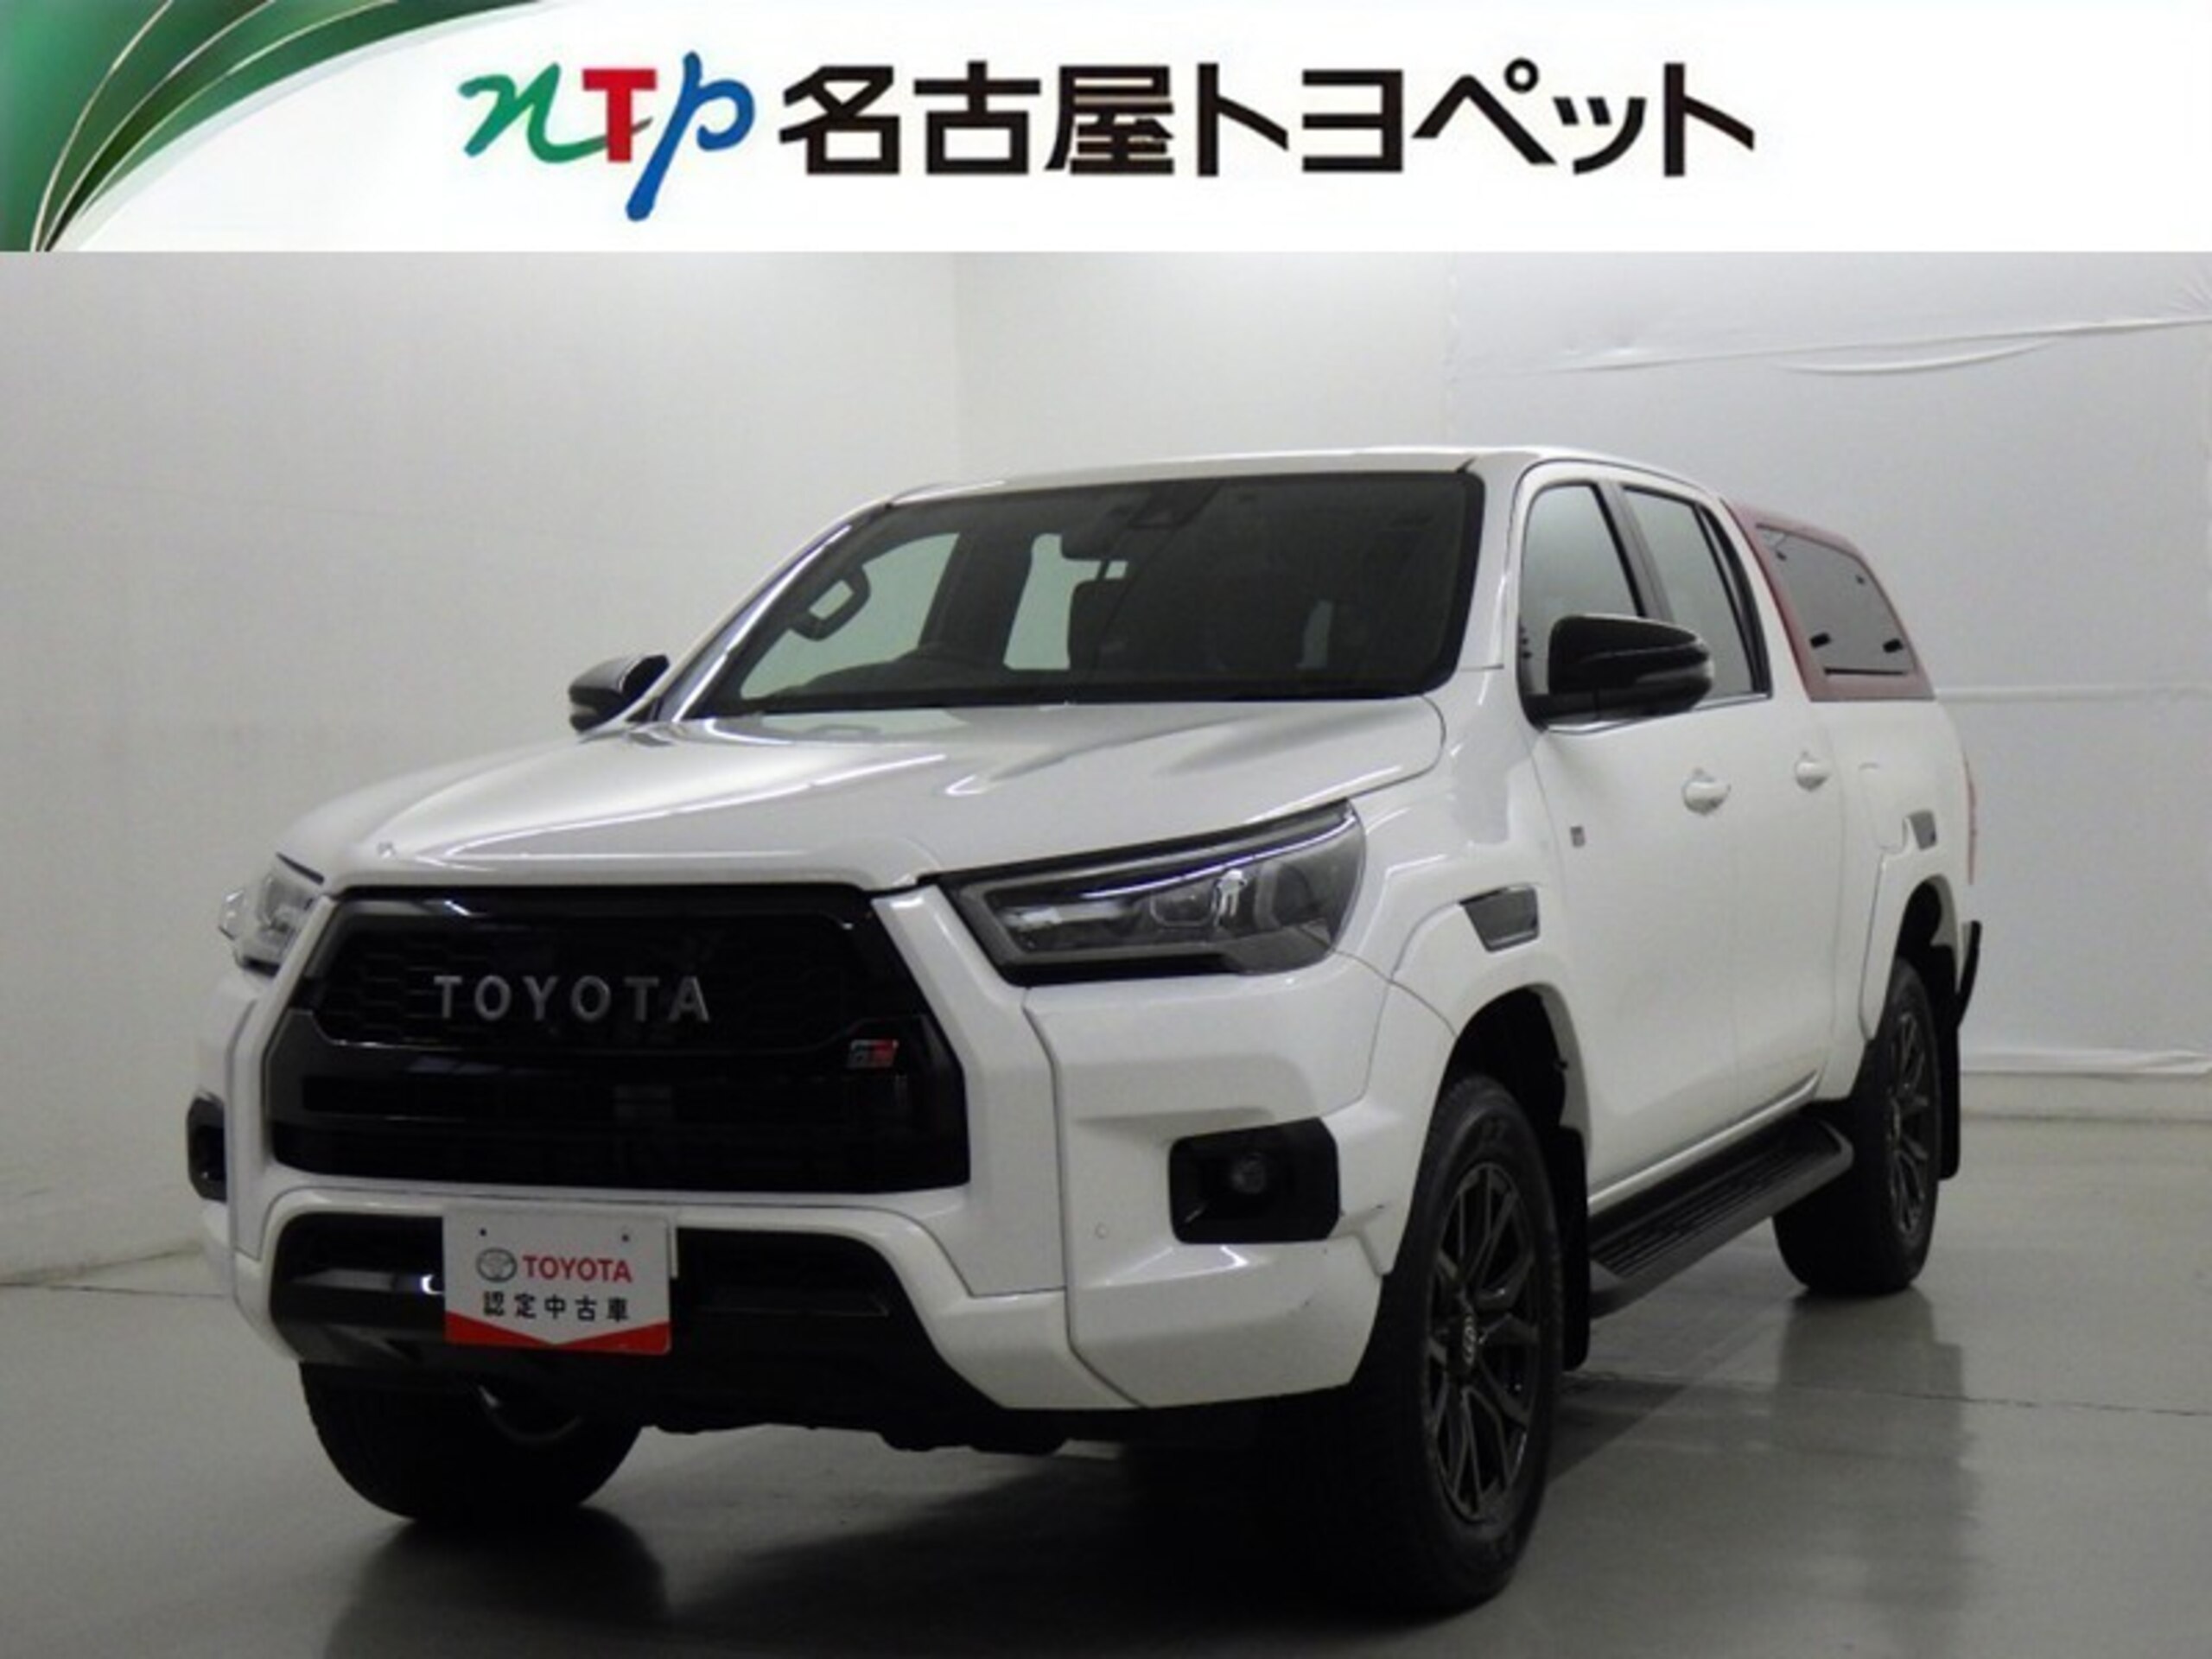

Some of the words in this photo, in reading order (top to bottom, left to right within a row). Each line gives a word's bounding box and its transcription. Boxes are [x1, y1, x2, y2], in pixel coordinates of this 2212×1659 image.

[433, 975, 709, 1023] TOYOTA
[523, 1255, 632, 1282] TOYOTA
[482, 1291, 628, 1322] 認定中古車
